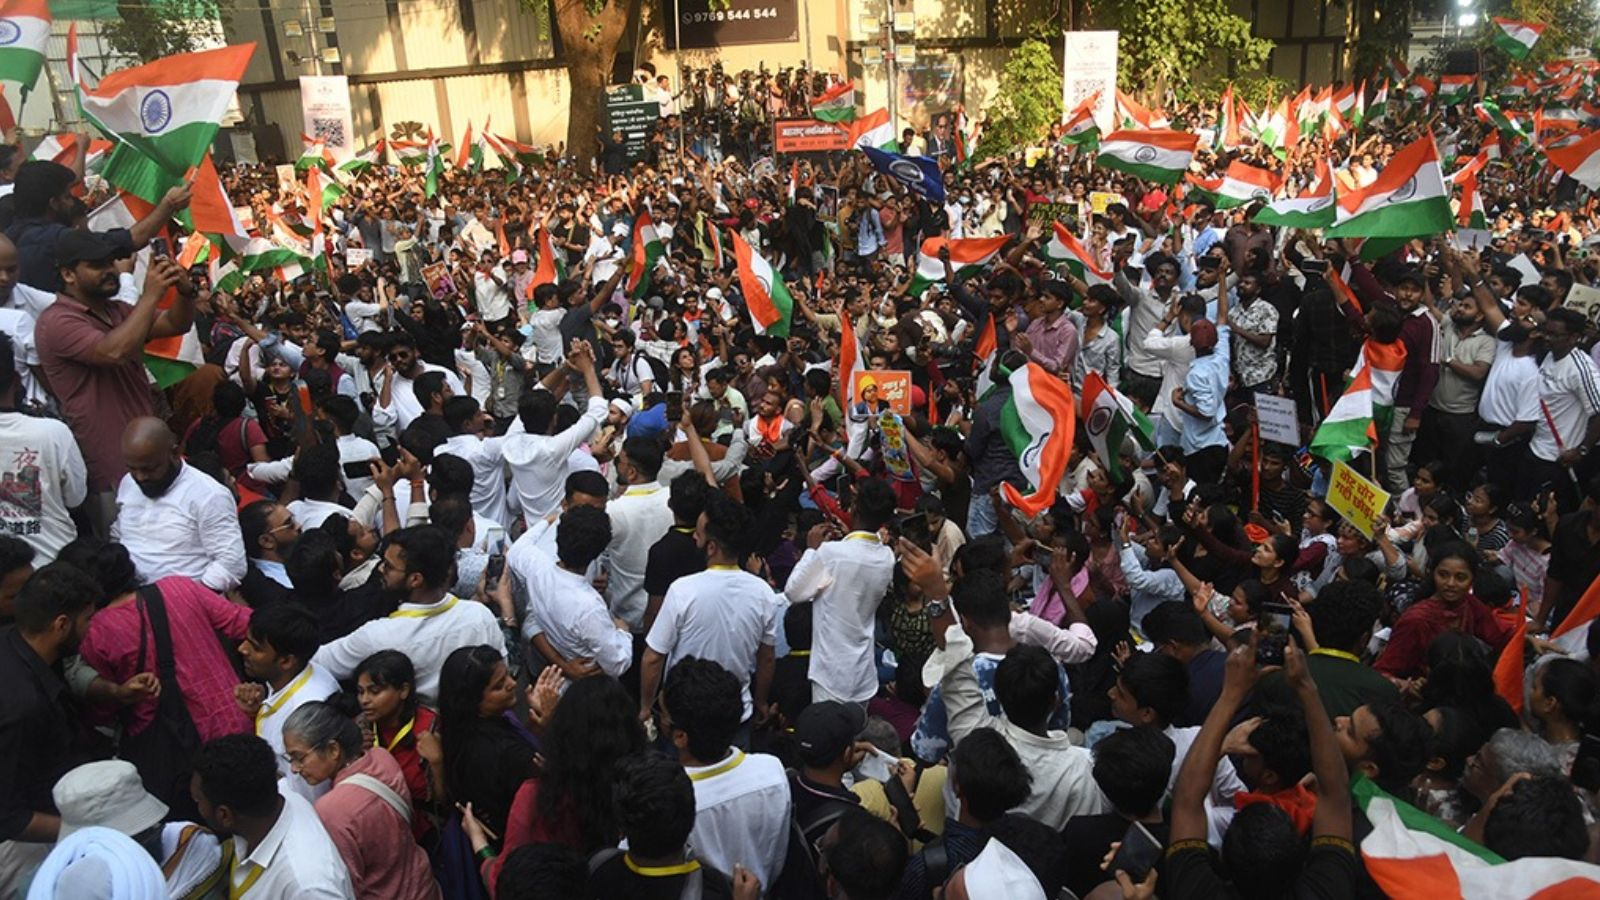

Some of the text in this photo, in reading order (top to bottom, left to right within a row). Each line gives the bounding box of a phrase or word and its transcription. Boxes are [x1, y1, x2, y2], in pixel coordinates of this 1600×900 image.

[694, 8, 777, 22] 9769 544 544
